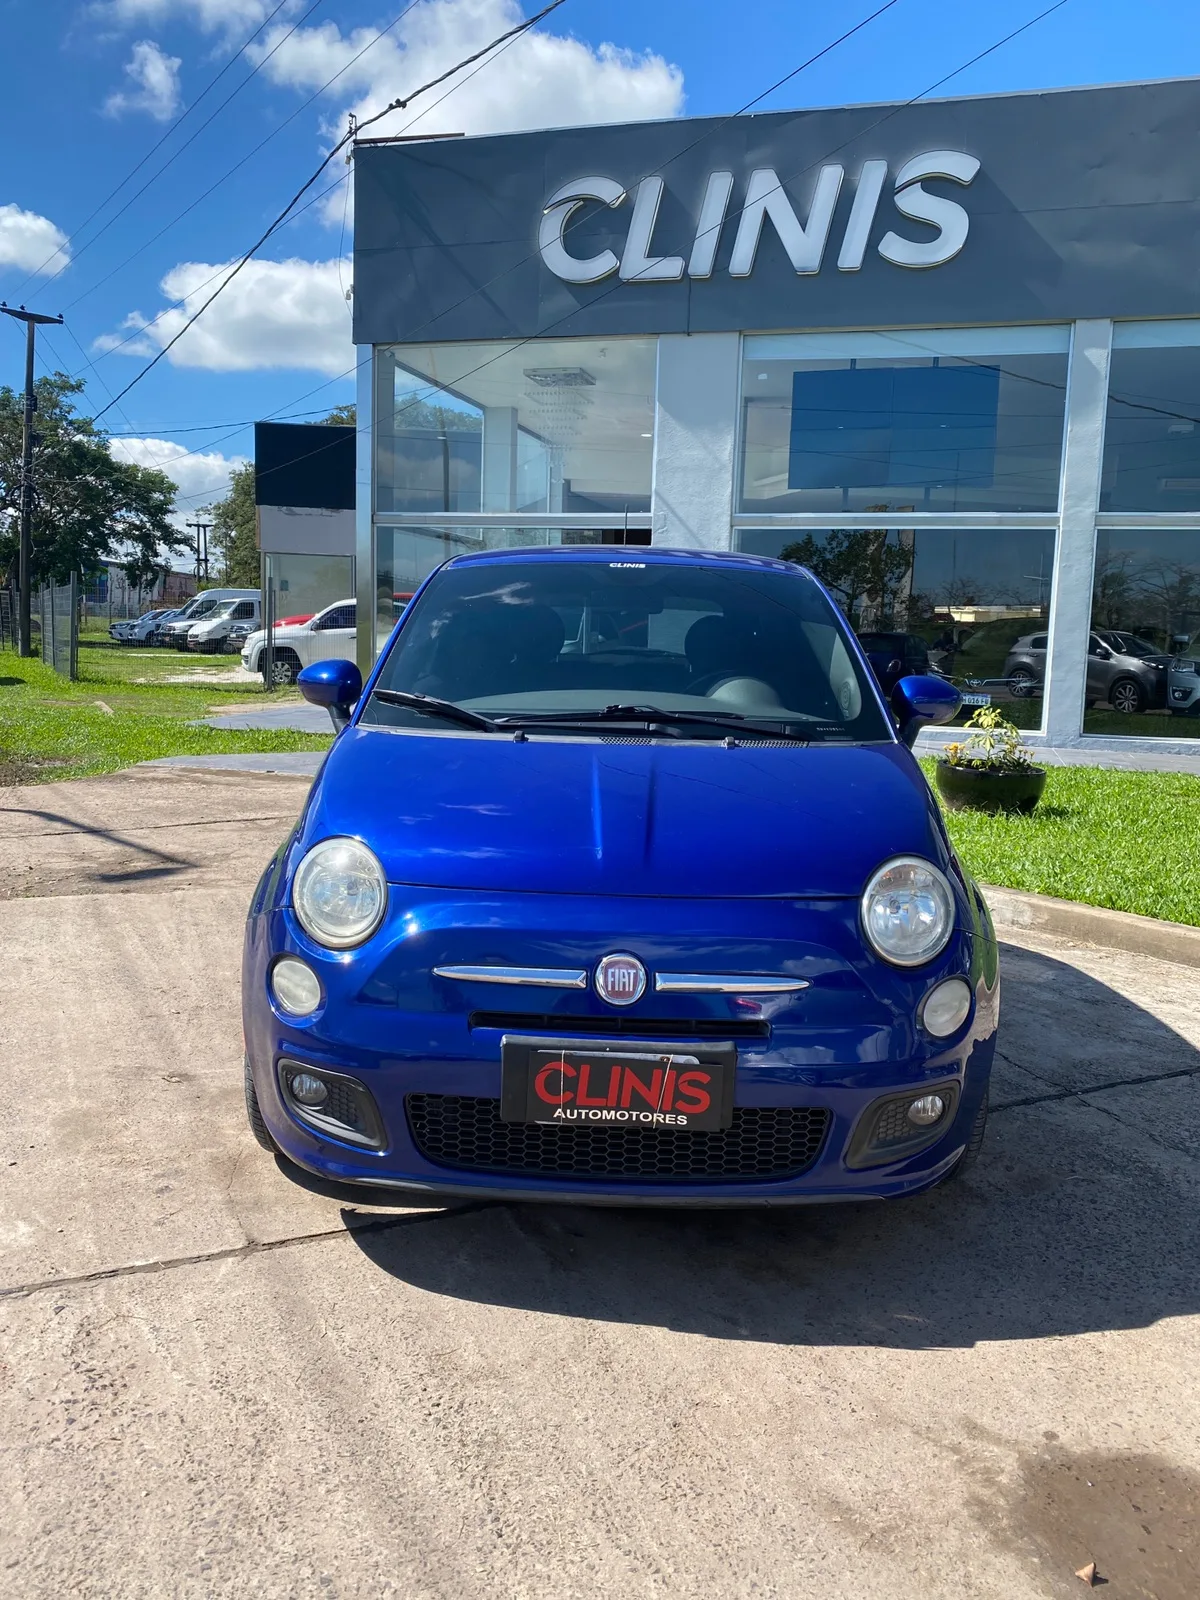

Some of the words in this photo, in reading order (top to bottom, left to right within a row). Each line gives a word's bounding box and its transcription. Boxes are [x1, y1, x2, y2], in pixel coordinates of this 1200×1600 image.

[538, 149, 981, 284] CLINIS
[607, 968, 636, 992] FIAT
[534, 1061, 712, 1114] CLINIS
[553, 1108, 688, 1126] AUTOMOTORES
